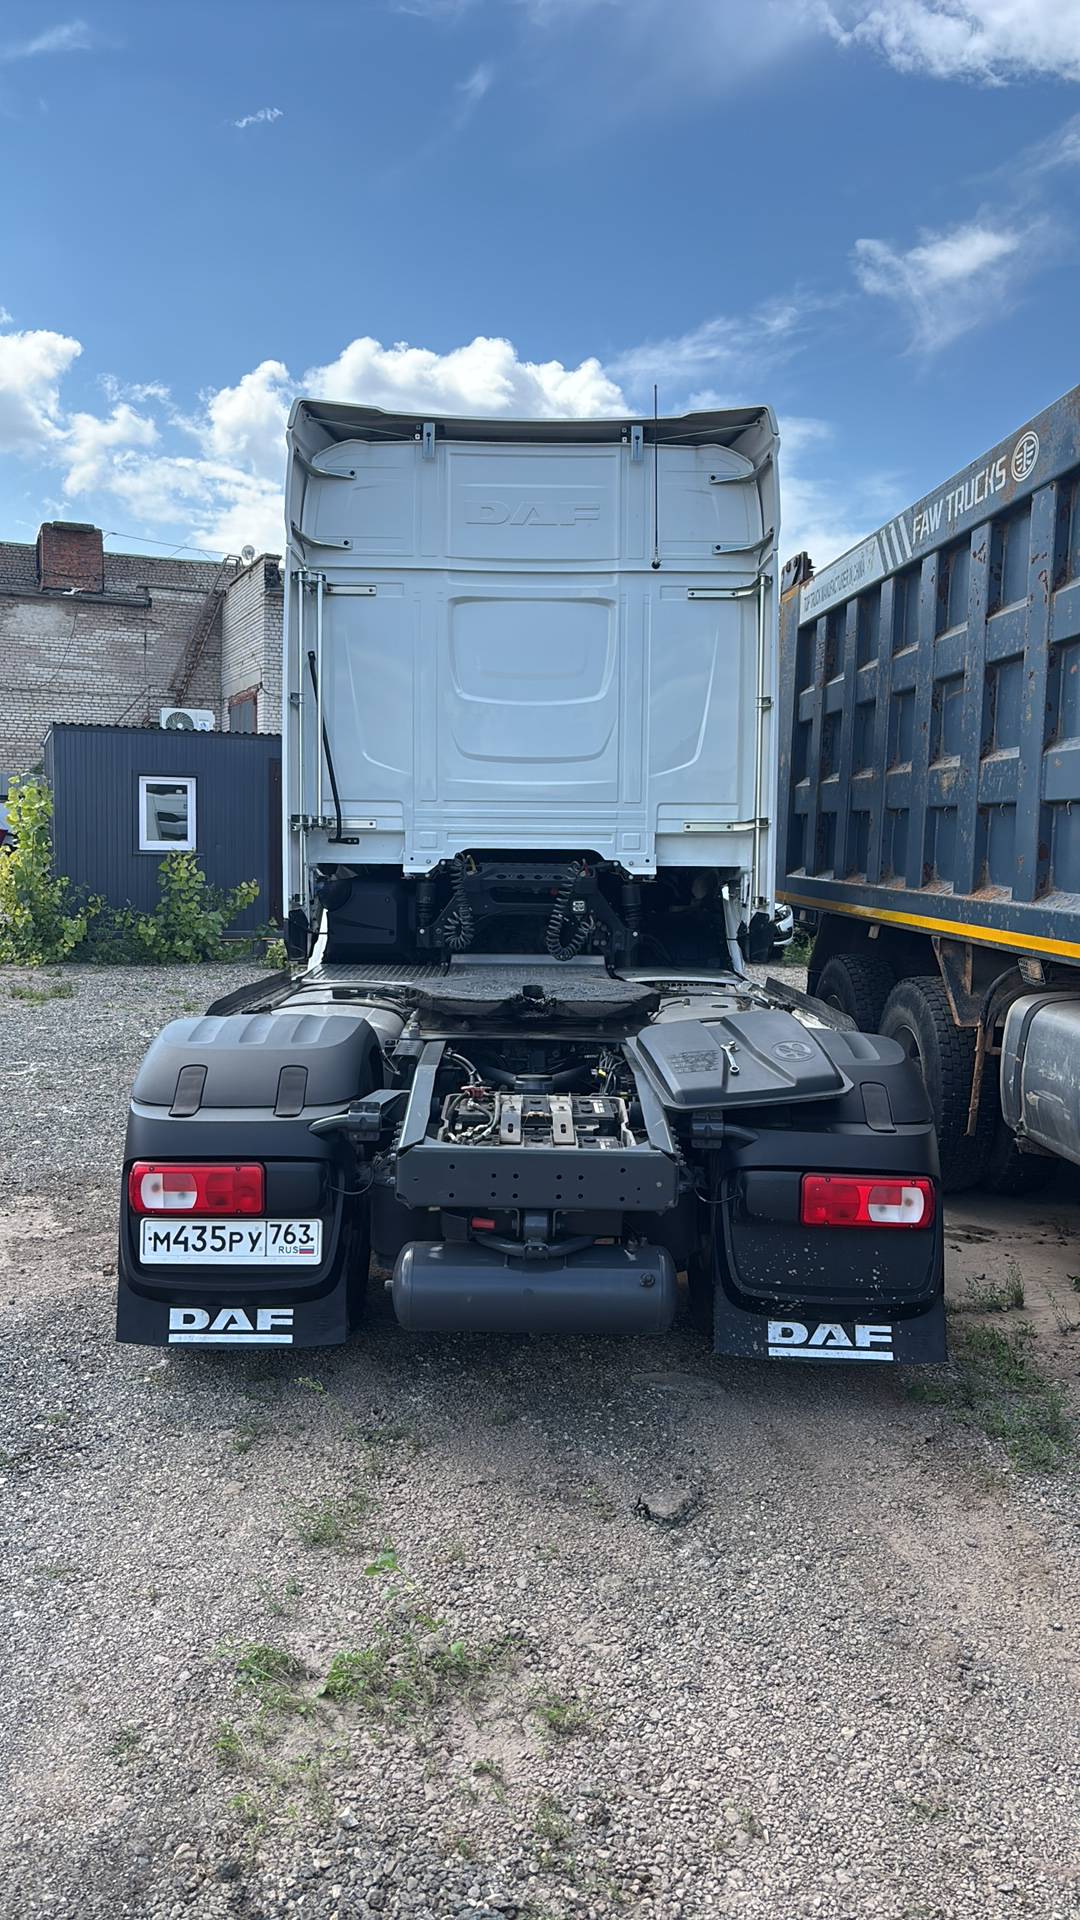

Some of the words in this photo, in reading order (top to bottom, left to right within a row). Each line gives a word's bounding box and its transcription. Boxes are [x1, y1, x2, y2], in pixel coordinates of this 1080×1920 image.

[912, 499, 943, 545] FAW
[946, 455, 1007, 522] TRUCKS
[464, 500, 600, 526] DAF
[269, 1223, 311, 1245] 763
[278, 1245, 298, 1254] RUS
[169, 1307, 294, 1330] DAF
[768, 1320, 893, 1347] DAF
